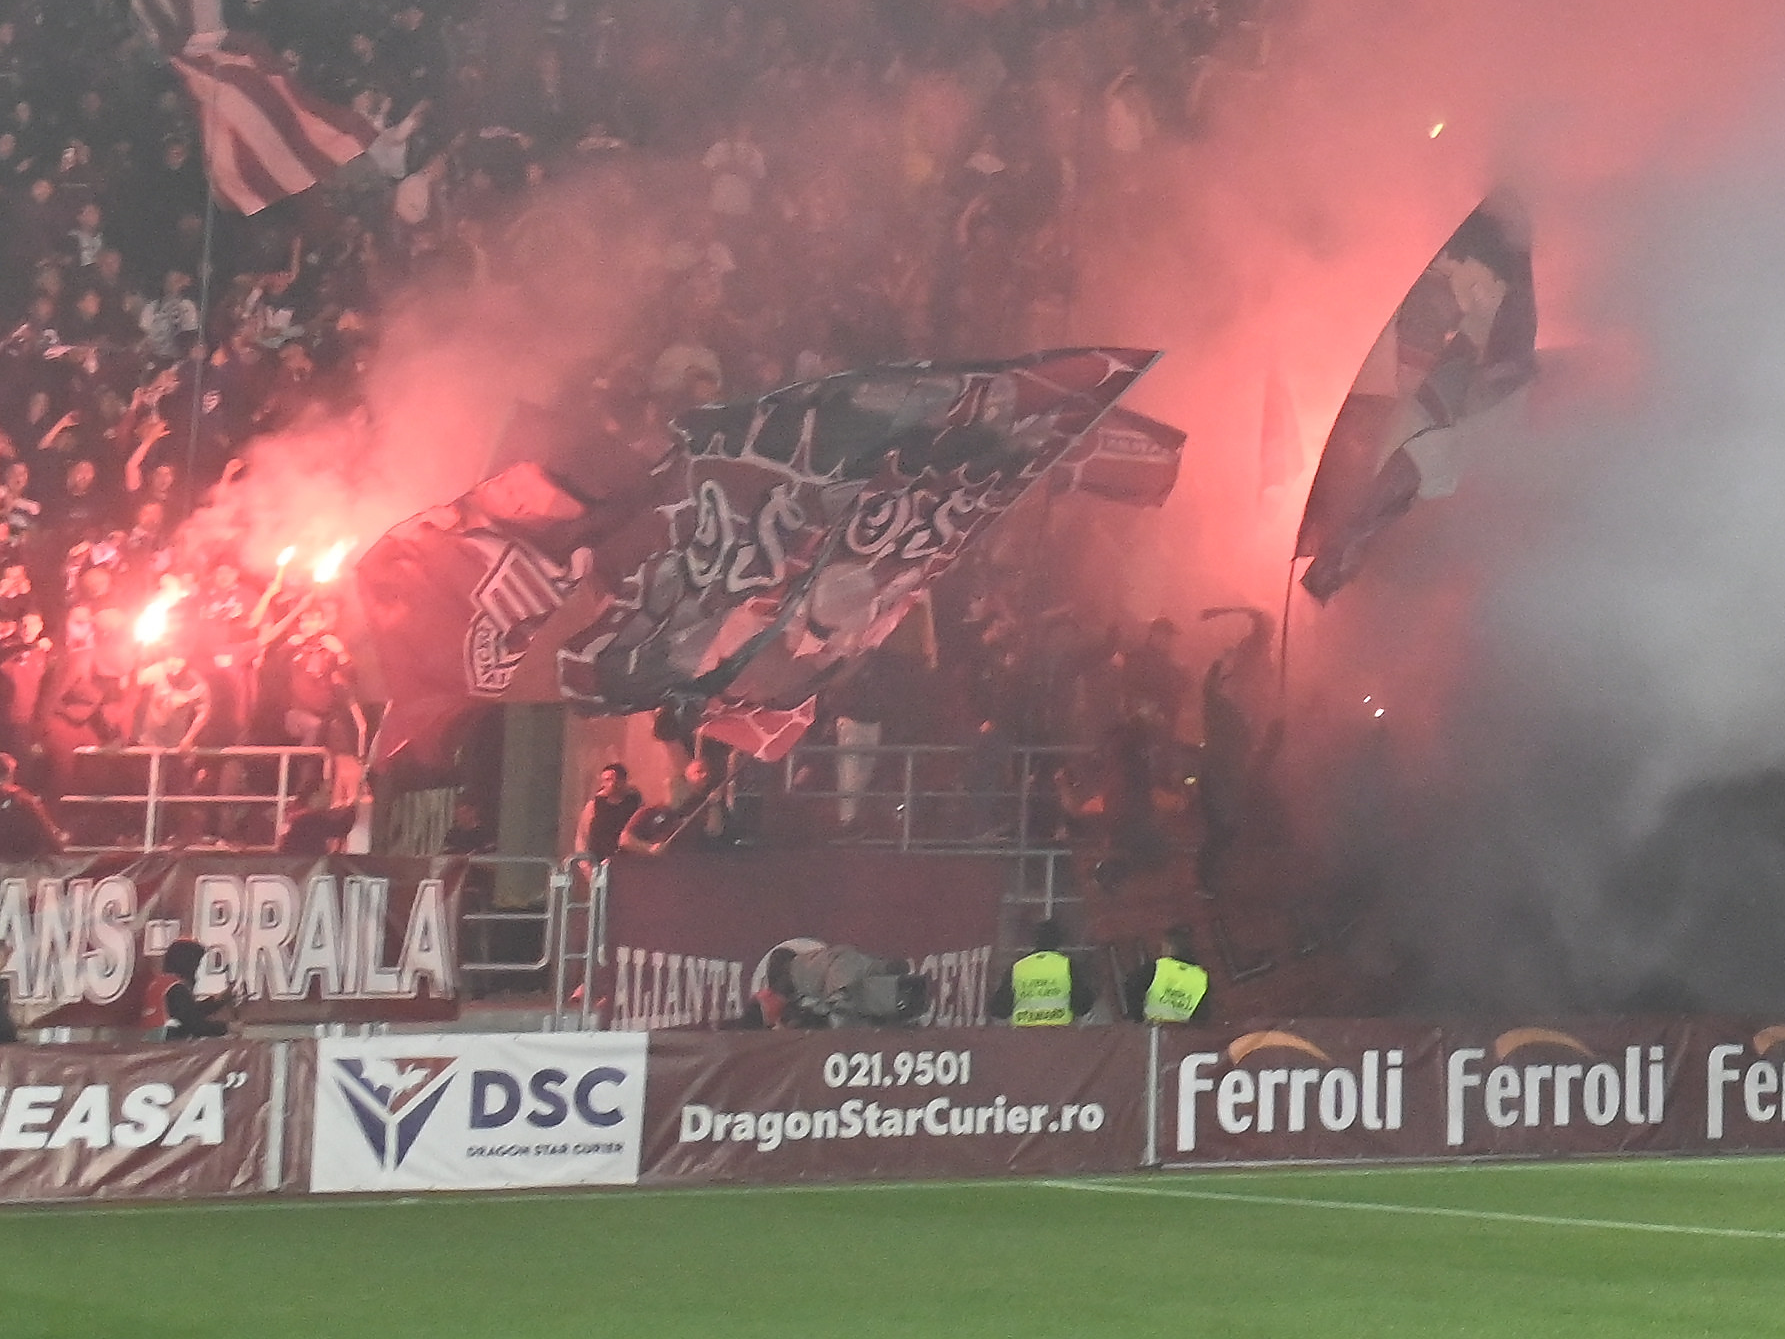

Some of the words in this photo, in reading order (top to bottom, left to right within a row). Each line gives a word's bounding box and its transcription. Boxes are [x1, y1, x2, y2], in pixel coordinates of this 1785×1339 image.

[193, 873, 459, 1001] BRAILA
[469, 1066, 627, 1129] DSC
[823, 1049, 972, 1089] 021.9501
[678, 1096, 1105, 1152] DragonStarCurier.ro
